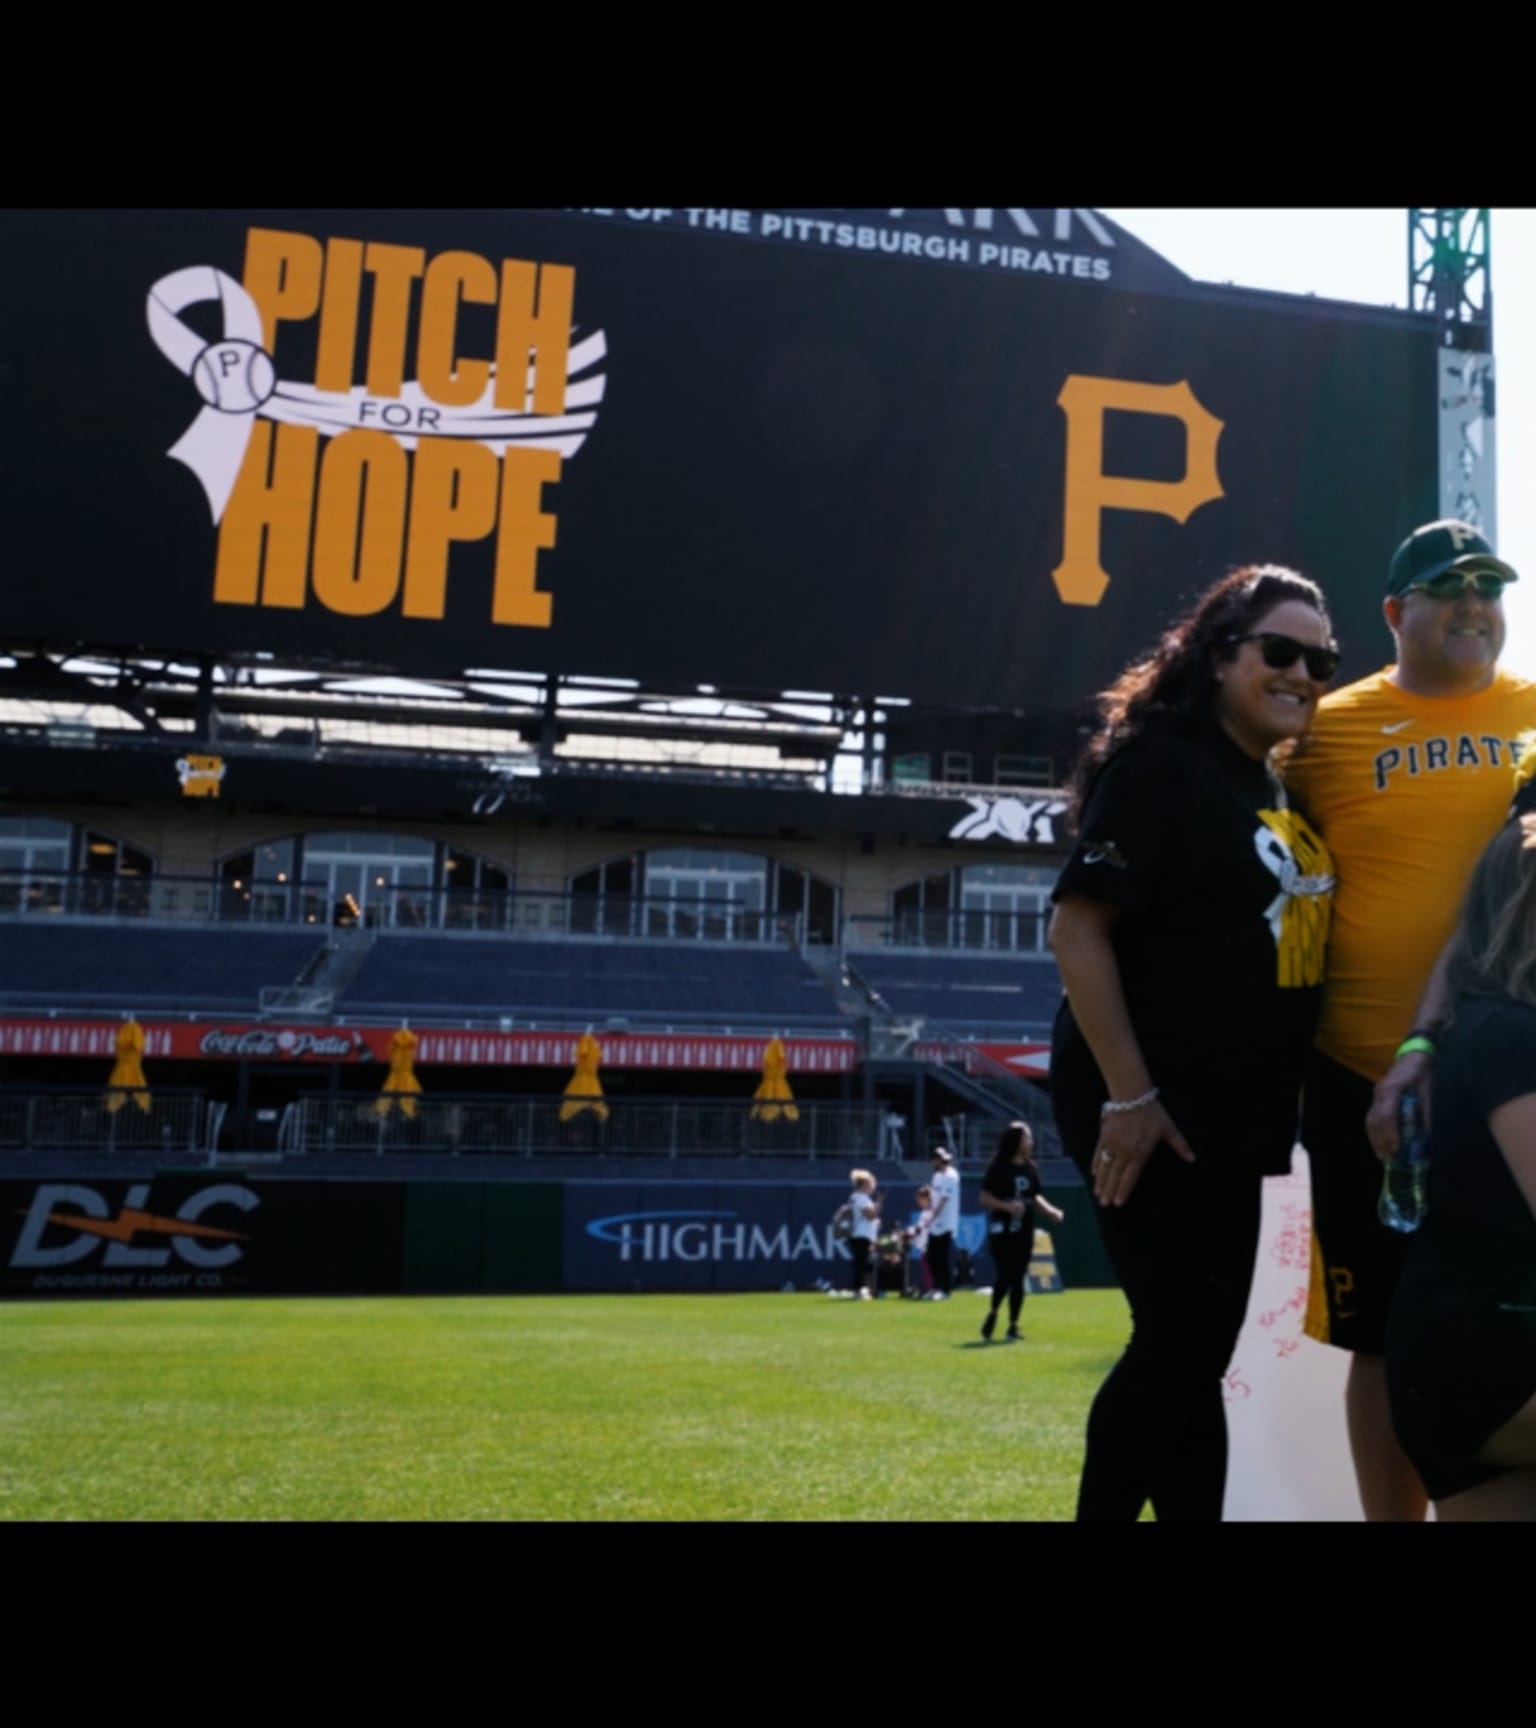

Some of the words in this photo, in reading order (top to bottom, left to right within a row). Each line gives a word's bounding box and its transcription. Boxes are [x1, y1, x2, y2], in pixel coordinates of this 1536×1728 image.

[684, 209, 751, 235] THE
[761, 213, 970, 263] PITTSBURGH
[980, 243, 1112, 282] PIRATES
[242, 227, 576, 416] PITCH
[357, 401, 442, 430] FOR
[212, 419, 562, 628] HOPE
[1052, 374, 1225, 606] P
[1374, 734, 1526, 791] PIRATE
[9, 1183, 261, 1267] DLC
[620, 1222, 852, 1261] HIGHMAR
[138, 1273, 191, 1288] LIGHT
